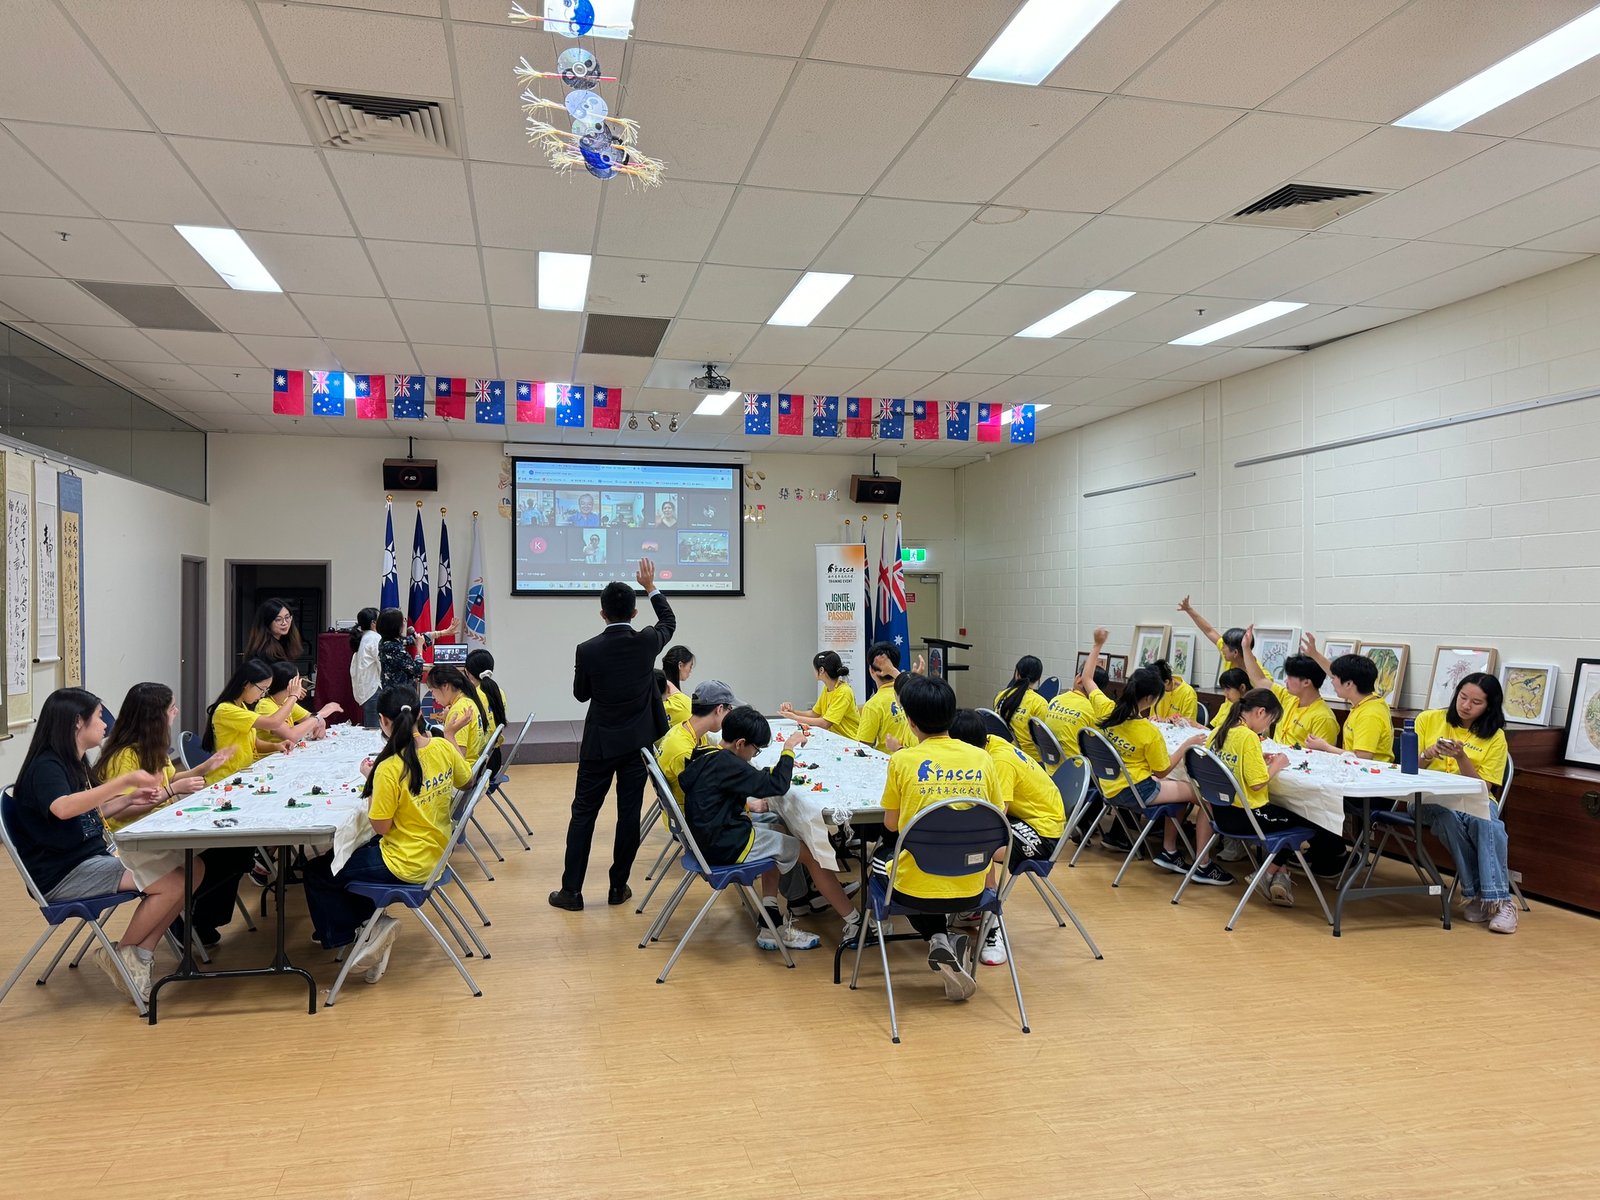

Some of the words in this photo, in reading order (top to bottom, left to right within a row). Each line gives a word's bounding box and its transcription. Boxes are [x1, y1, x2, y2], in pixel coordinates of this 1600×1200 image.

[534, 541, 541, 550] K
[831, 593, 850, 602] IGNITE
[825, 602, 841, 611] YOUR
[842, 602, 856, 611] NEW
[828, 612, 854, 622] PASSION
[1055, 705, 1081, 718] FASCA
[1108, 732, 1136, 752] FASCA
[936, 769, 982, 781] FASCA
[1011, 821, 1042, 846] NIKE
